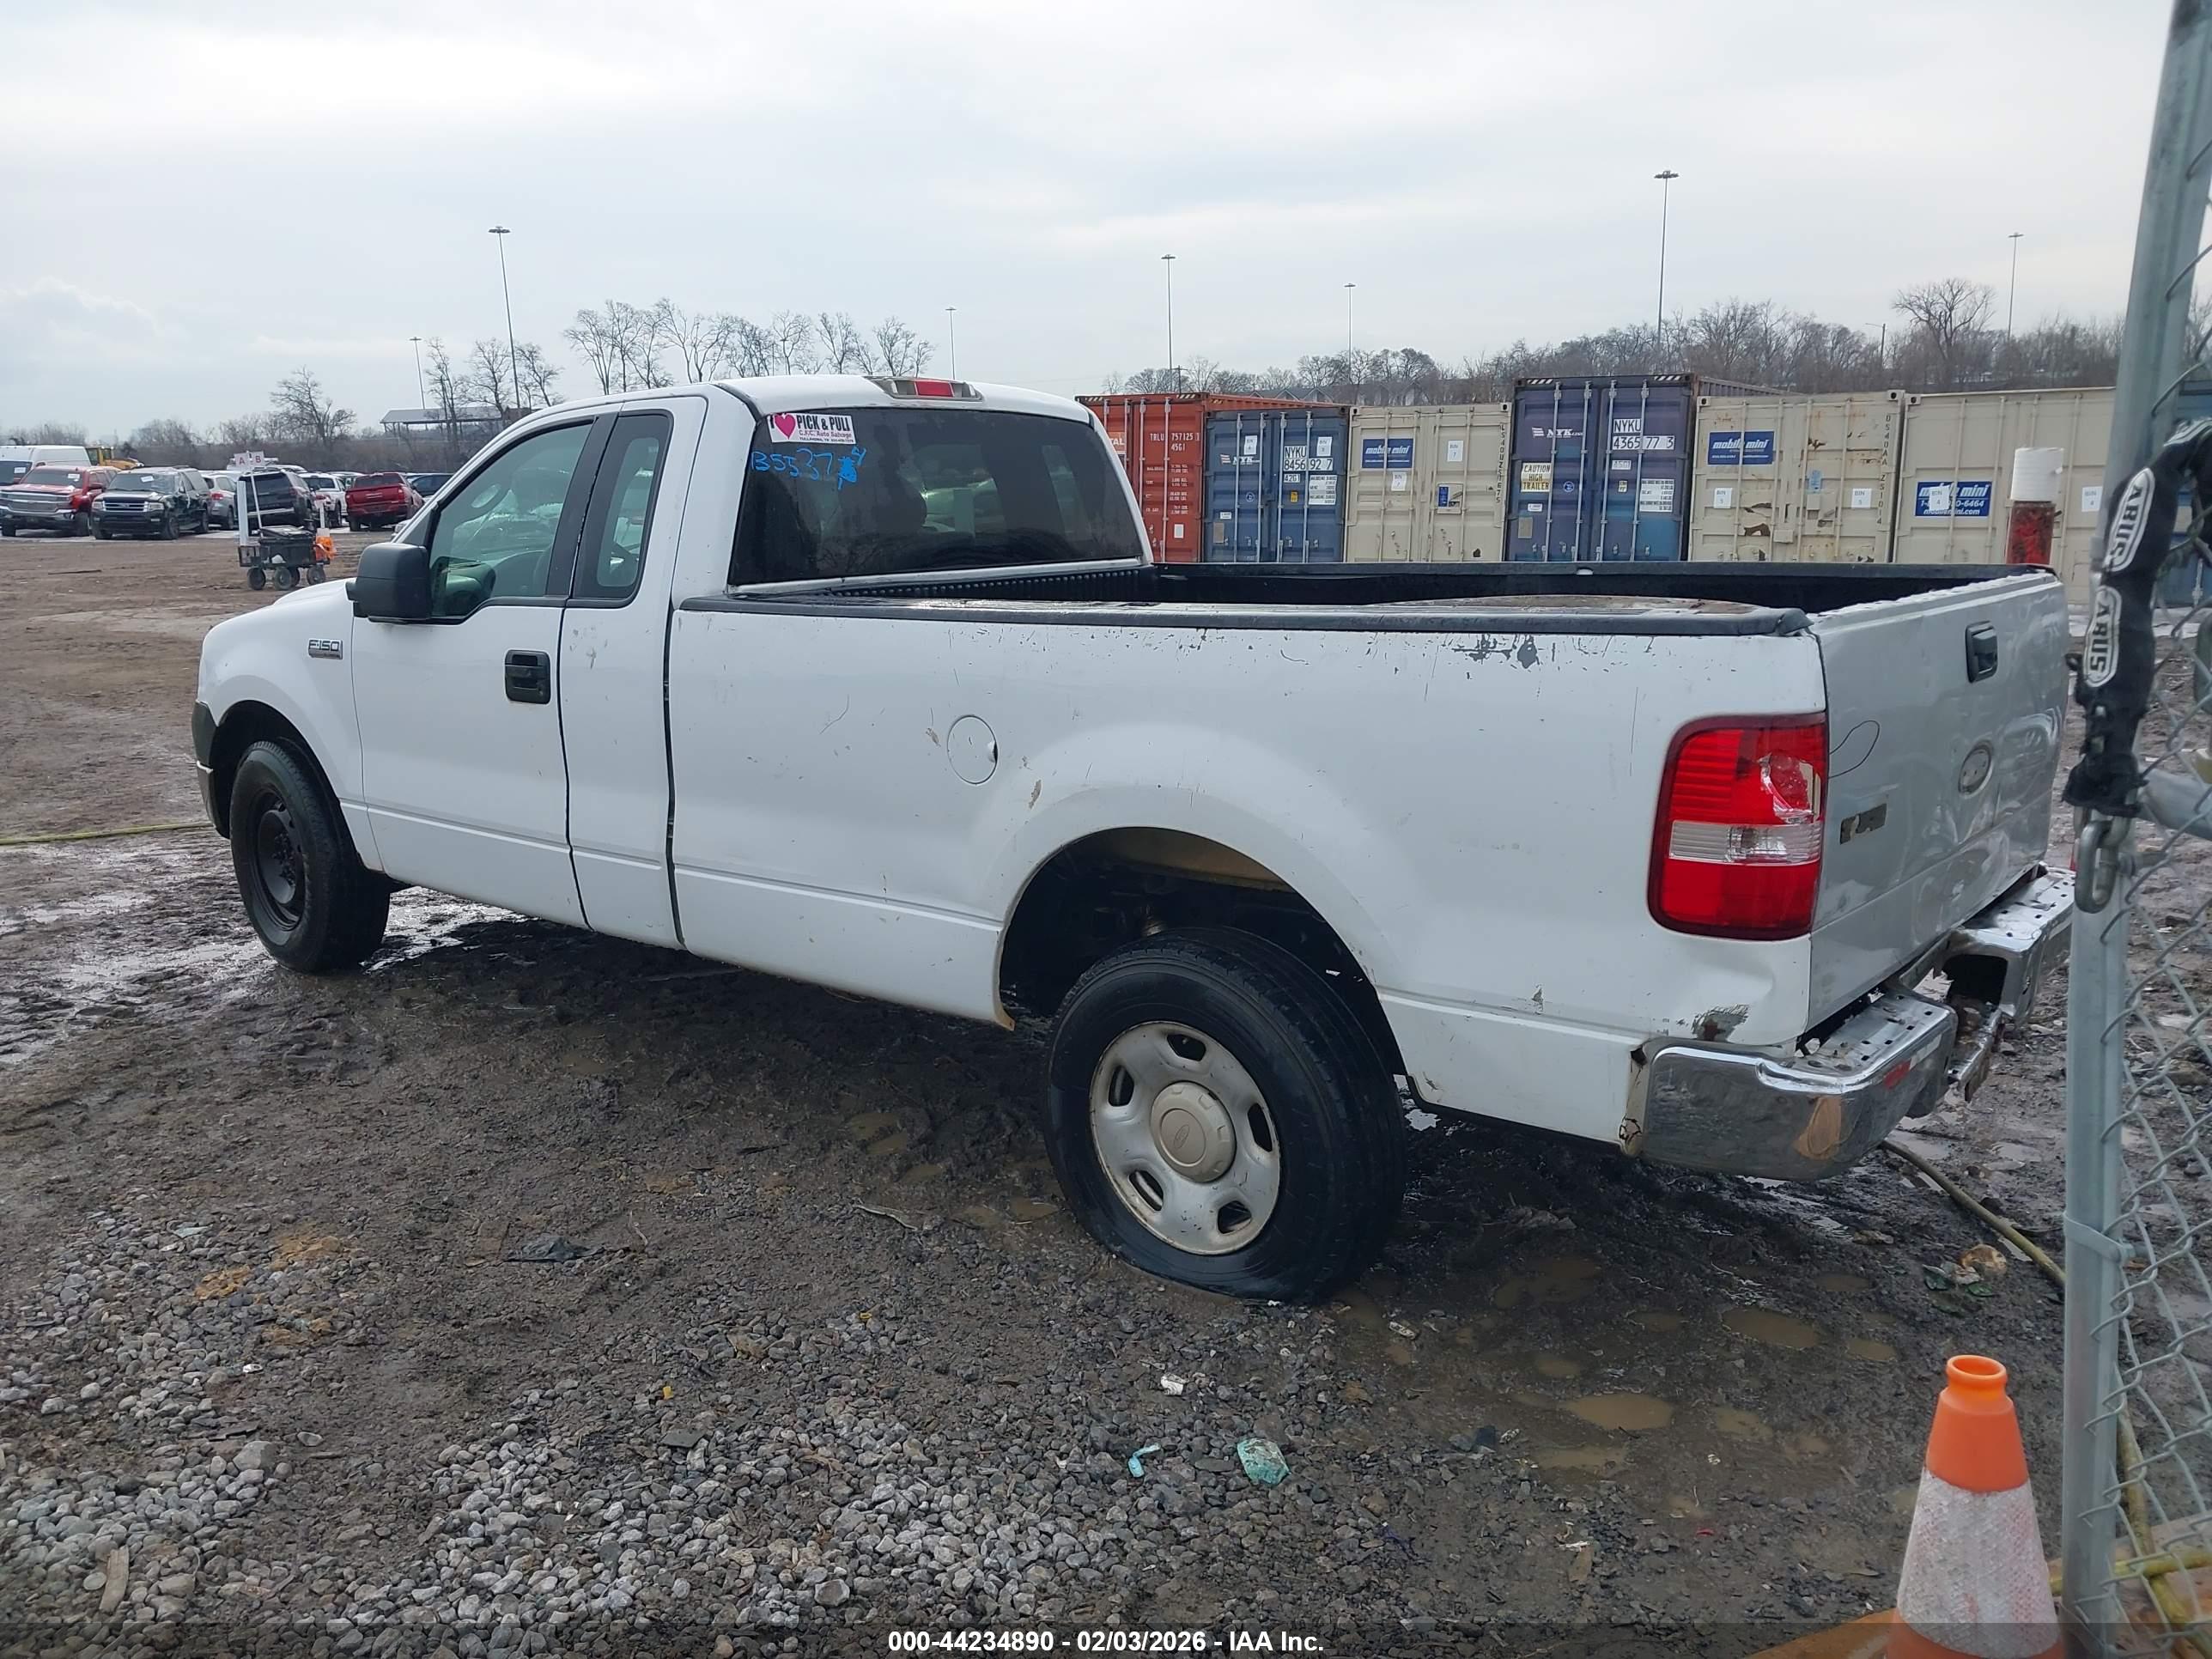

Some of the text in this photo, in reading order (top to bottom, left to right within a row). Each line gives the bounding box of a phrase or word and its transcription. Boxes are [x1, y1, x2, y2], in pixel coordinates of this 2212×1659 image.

[796, 415, 820, 430] PICK
[821, 417, 829, 430] &
[829, 416, 851, 431] PULL
[1613, 419, 1641, 432] NYKU
[1150, 433, 1164, 441] TRLU
[1171, 432, 1194, 441] 757125
[1546, 428, 1572, 438] NYK
[1171, 443, 1186, 452] 45G1
[1613, 436, 1674, 449] 4365 77 3
[1712, 438, 1770, 449] mobil mini
[1285, 446, 1307, 458] NYKU
[1365, 445, 1410, 454] mobie mini
[255, 455, 262, 464] B
[1232, 456, 1255, 465] NYK
[1284, 459, 1333, 471] 8456 92 7
[1523, 465, 1551, 473] CAUTION
[1528, 473, 1543, 482] HIGH
[1523, 482, 1550, 490] TRAILER
[1960, 484, 1990, 497] mini
[2110, 484, 2142, 559] ABUS
[2090, 604, 2112, 673] ABUS
